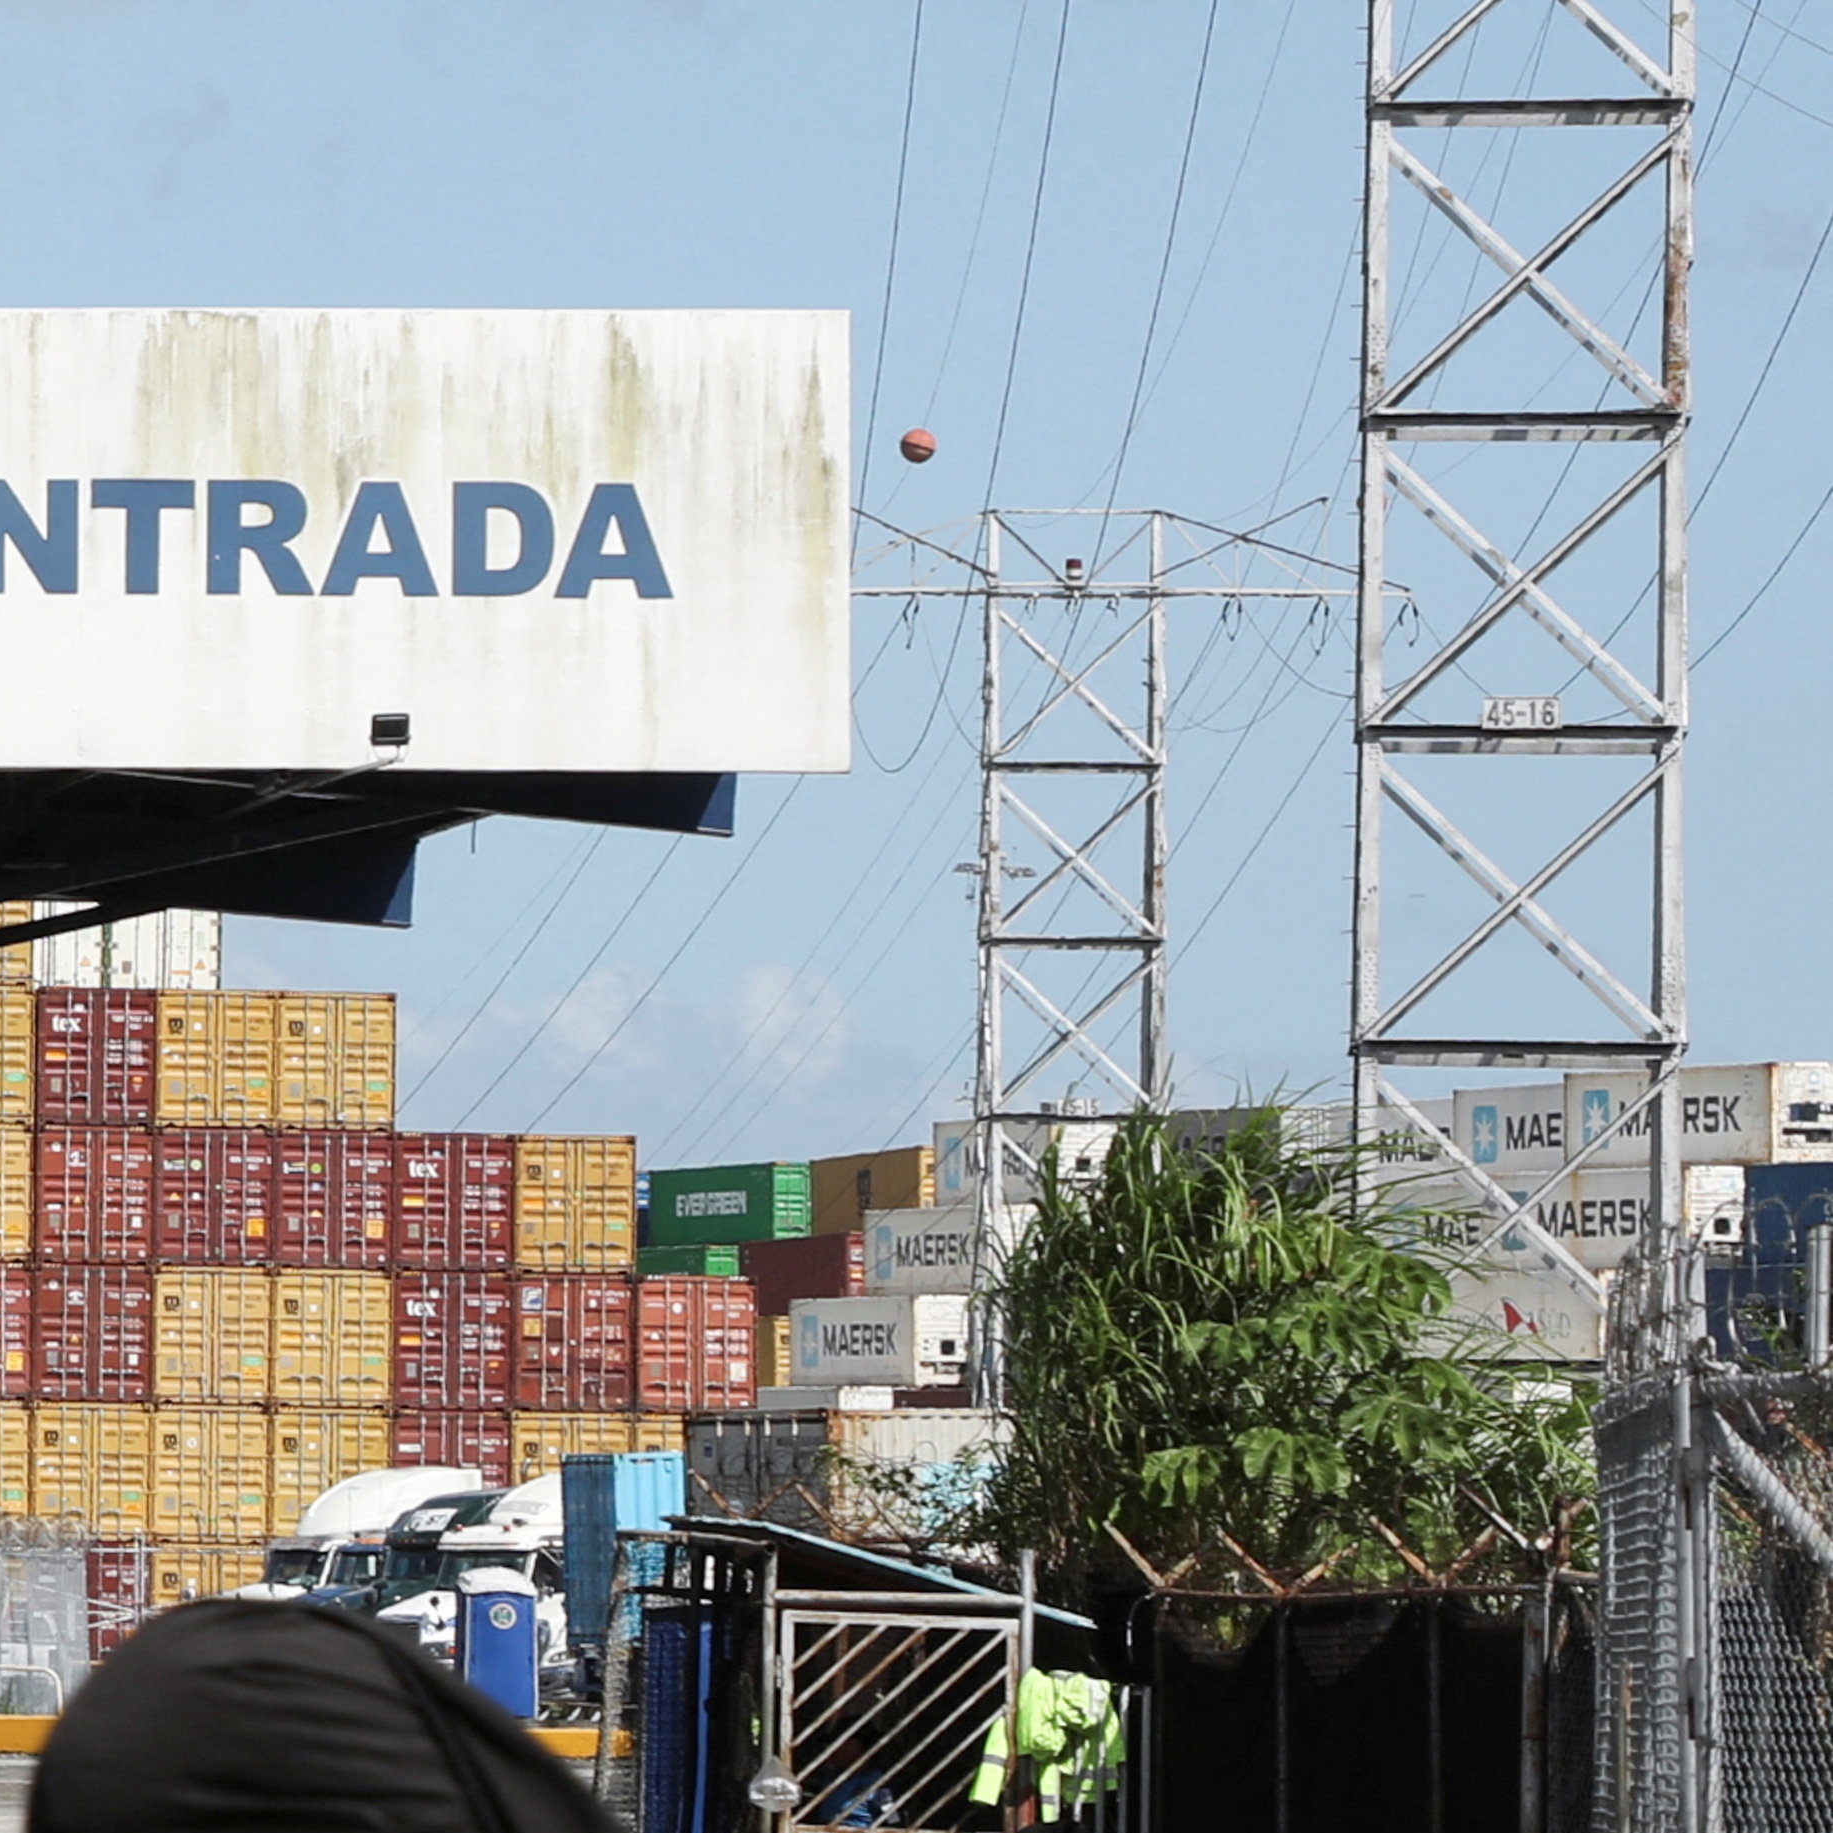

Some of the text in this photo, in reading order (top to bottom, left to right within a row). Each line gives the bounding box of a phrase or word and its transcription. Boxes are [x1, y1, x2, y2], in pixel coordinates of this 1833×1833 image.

[1486, 700, 1555, 727] 45-16
[676, 1190, 747, 1218] EVERGREEN
[896, 1233, 970, 1267] MAERSK
[822, 1322, 897, 1357] MAERSK
